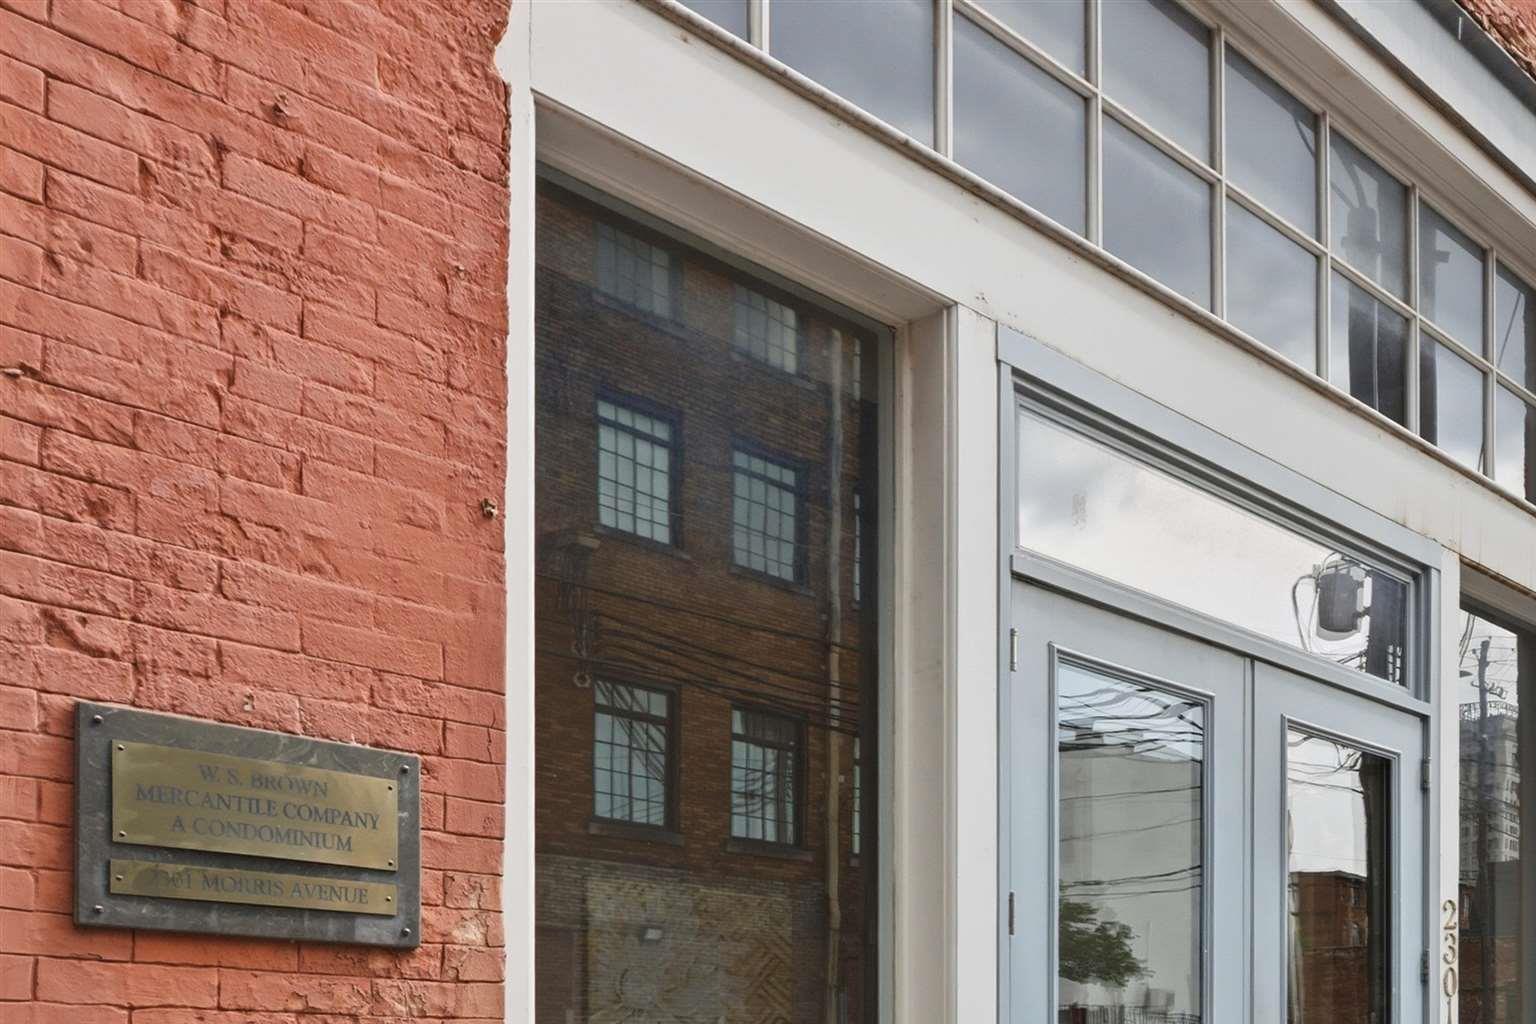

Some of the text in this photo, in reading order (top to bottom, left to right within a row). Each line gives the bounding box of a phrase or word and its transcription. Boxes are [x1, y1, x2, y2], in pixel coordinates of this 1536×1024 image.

[200, 764, 328, 798] W. S. BROWN
[136, 784, 380, 830] MERCANTILE COMPANY
[171, 815, 353, 851] A CONDOMINIUM
[201, 874, 284, 897] MORRIS
[290, 883, 368, 904] AVENUE
